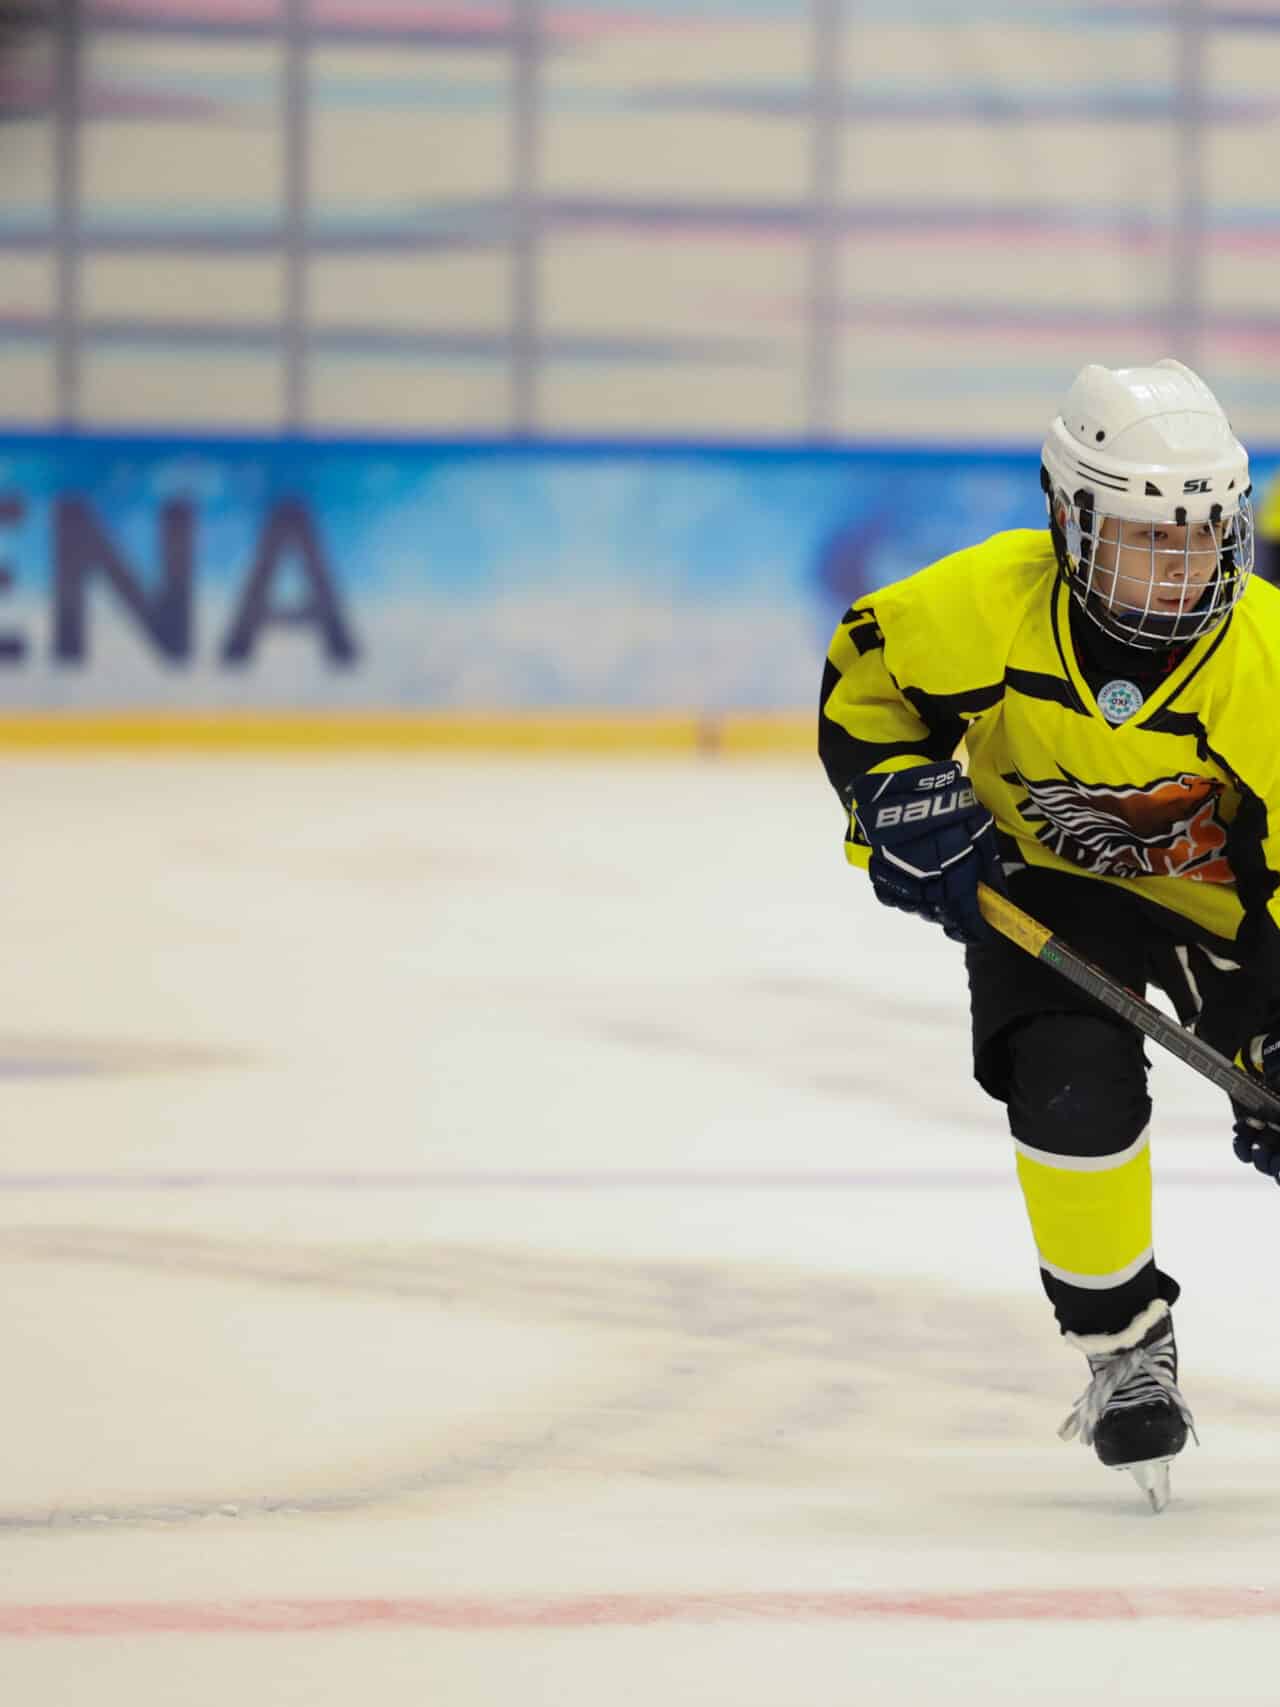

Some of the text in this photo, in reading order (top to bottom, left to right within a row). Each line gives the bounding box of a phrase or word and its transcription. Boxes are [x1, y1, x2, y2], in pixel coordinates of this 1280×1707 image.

[0, 493, 360, 670] NA
[914, 770, 955, 791] S29
[875, 788, 978, 828] BAUE
